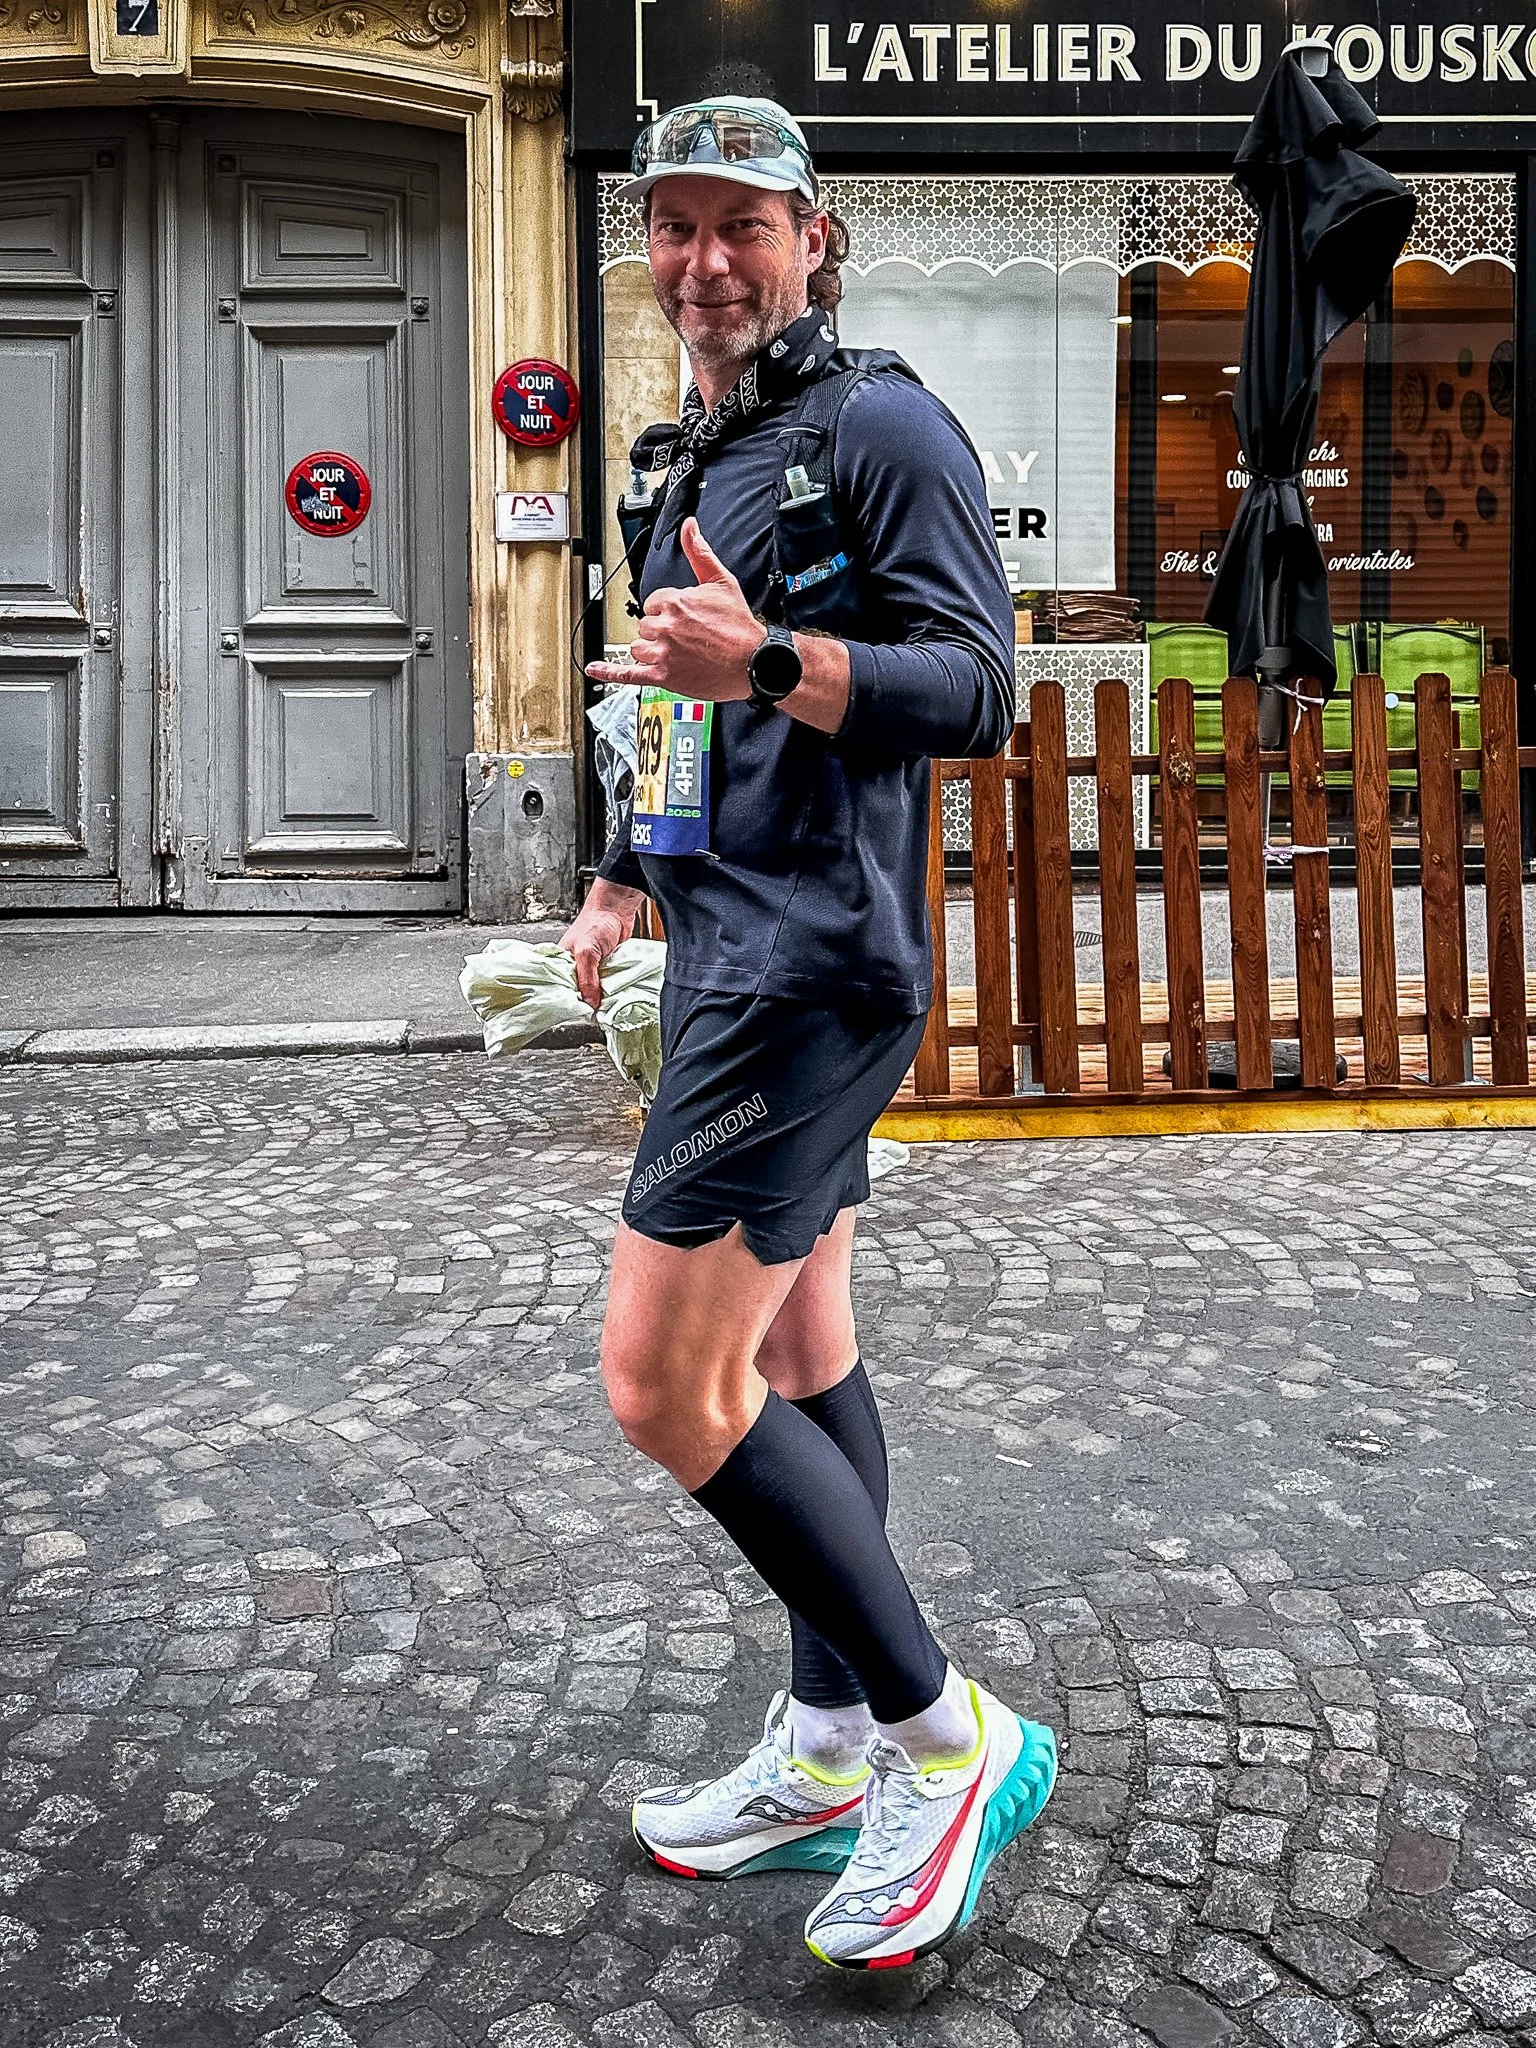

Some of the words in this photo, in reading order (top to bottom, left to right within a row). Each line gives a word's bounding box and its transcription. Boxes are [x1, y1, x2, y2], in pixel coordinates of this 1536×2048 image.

[128, 0, 150, 31] 7
[814, 23, 1141, 82] L'ATELIER
[1165, 24, 1262, 82] DU
[1292, 24, 1536, 83] OUSK
[517, 375, 554, 391] JOUR
[527, 395, 546, 410] ET
[520, 414, 552, 429] NUIT
[310, 468, 345, 482] JOUR
[319, 487, 336, 501] ET
[313, 505, 344, 519] NUIT
[1160, 551, 1200, 573] Thé
[1202, 551, 1219, 576] &
[1328, 549, 1415, 571] orientales
[674, 736, 695, 796] 4H15
[631, 1092, 768, 1204] SALOMON
